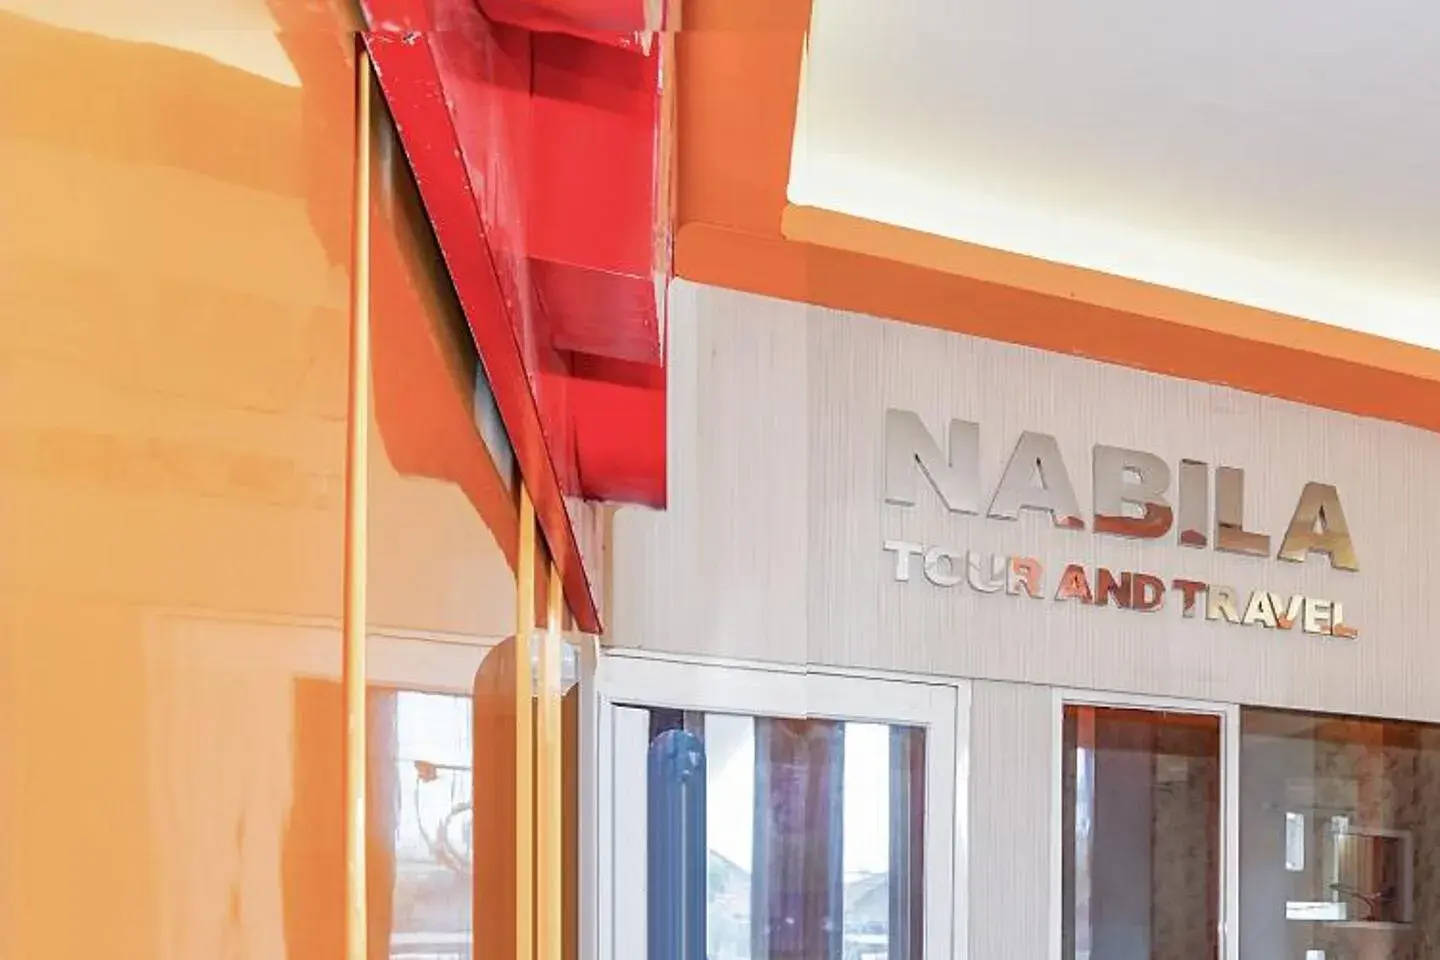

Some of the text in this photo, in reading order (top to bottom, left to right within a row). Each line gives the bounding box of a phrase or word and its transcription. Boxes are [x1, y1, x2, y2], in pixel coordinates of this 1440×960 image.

[885, 409, 1359, 572] NABILA
[883, 540, 1359, 639] TOUR AND TRAVEL
